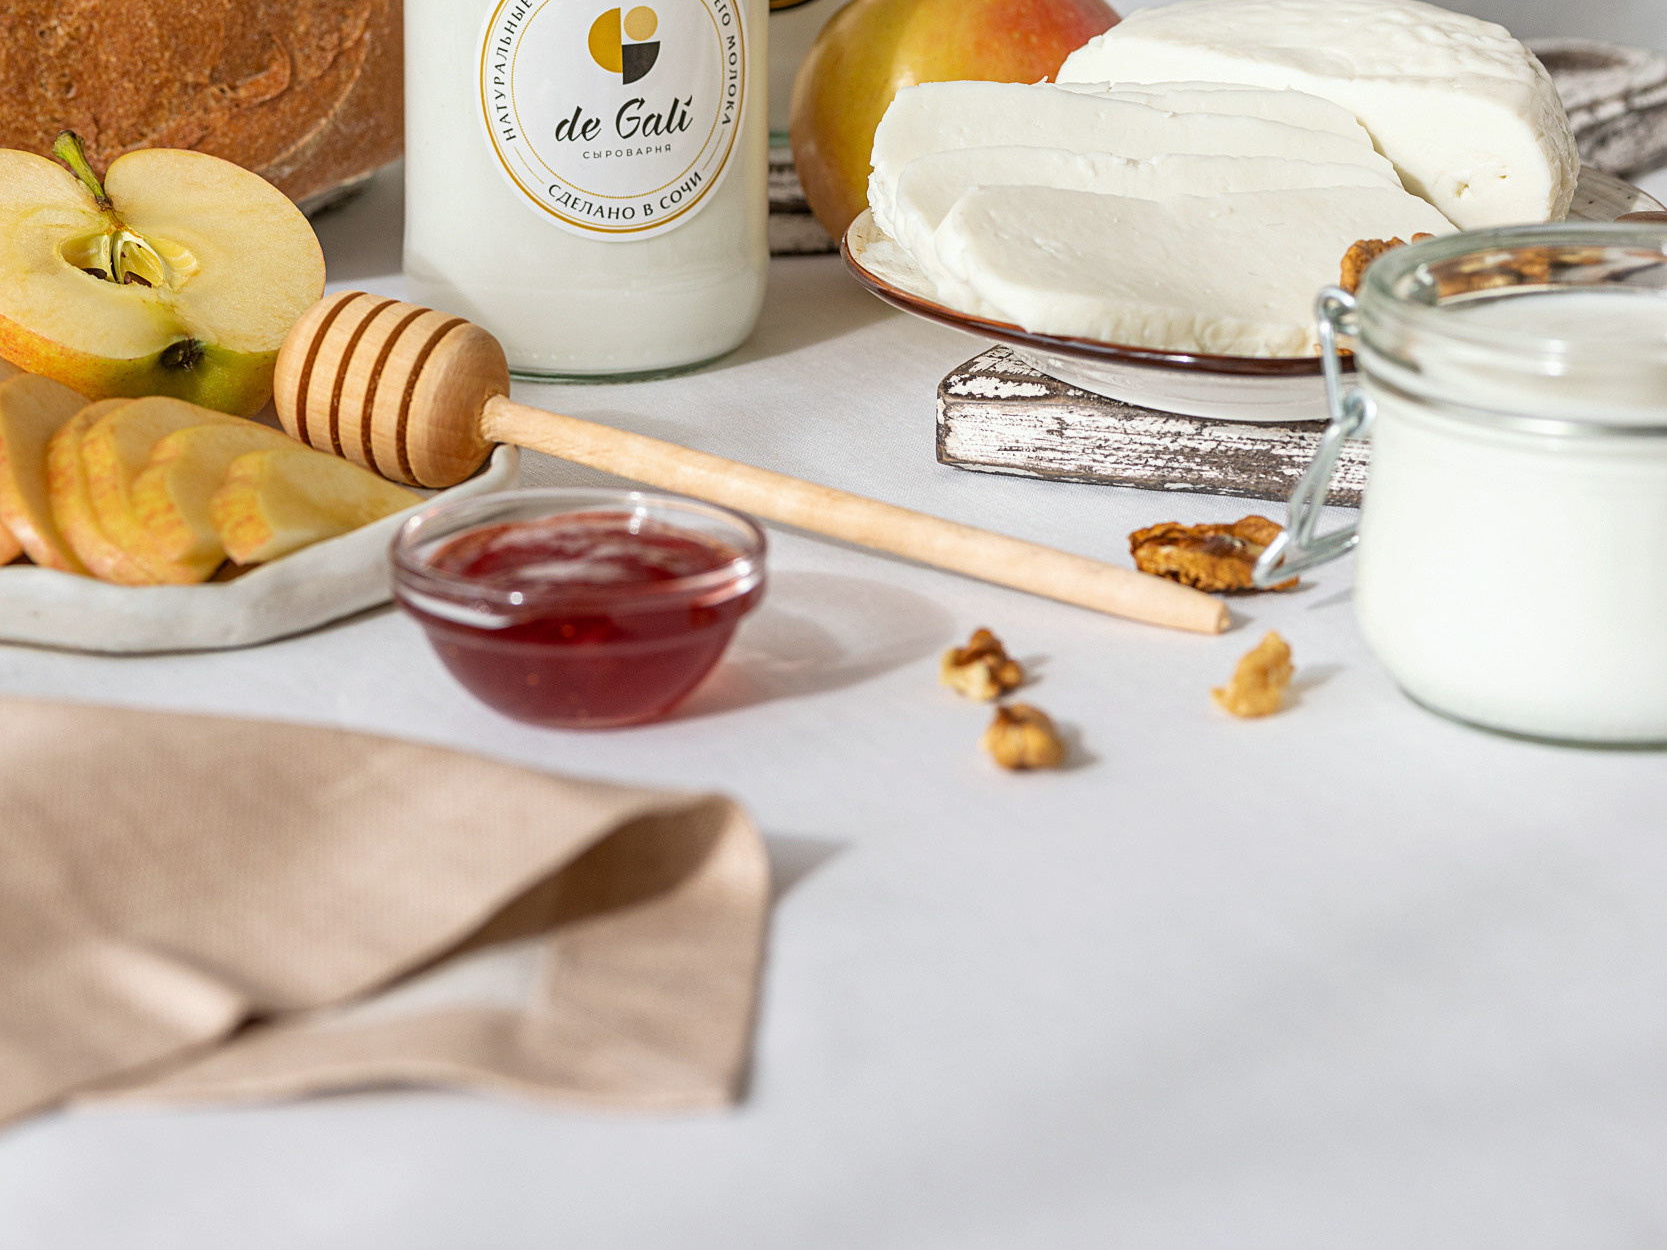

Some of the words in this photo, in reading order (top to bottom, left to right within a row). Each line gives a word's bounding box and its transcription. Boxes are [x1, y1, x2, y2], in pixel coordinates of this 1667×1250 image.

[722, 35, 738, 125] МОЛОКА
[555, 105, 602, 142] de
[582, 144, 672, 159] СЫРОВАРНЯ
[548, 184, 636, 220] СДЕЛАНО
[643, 203, 654, 217] В
[660, 171, 703, 210] СОЧИ
